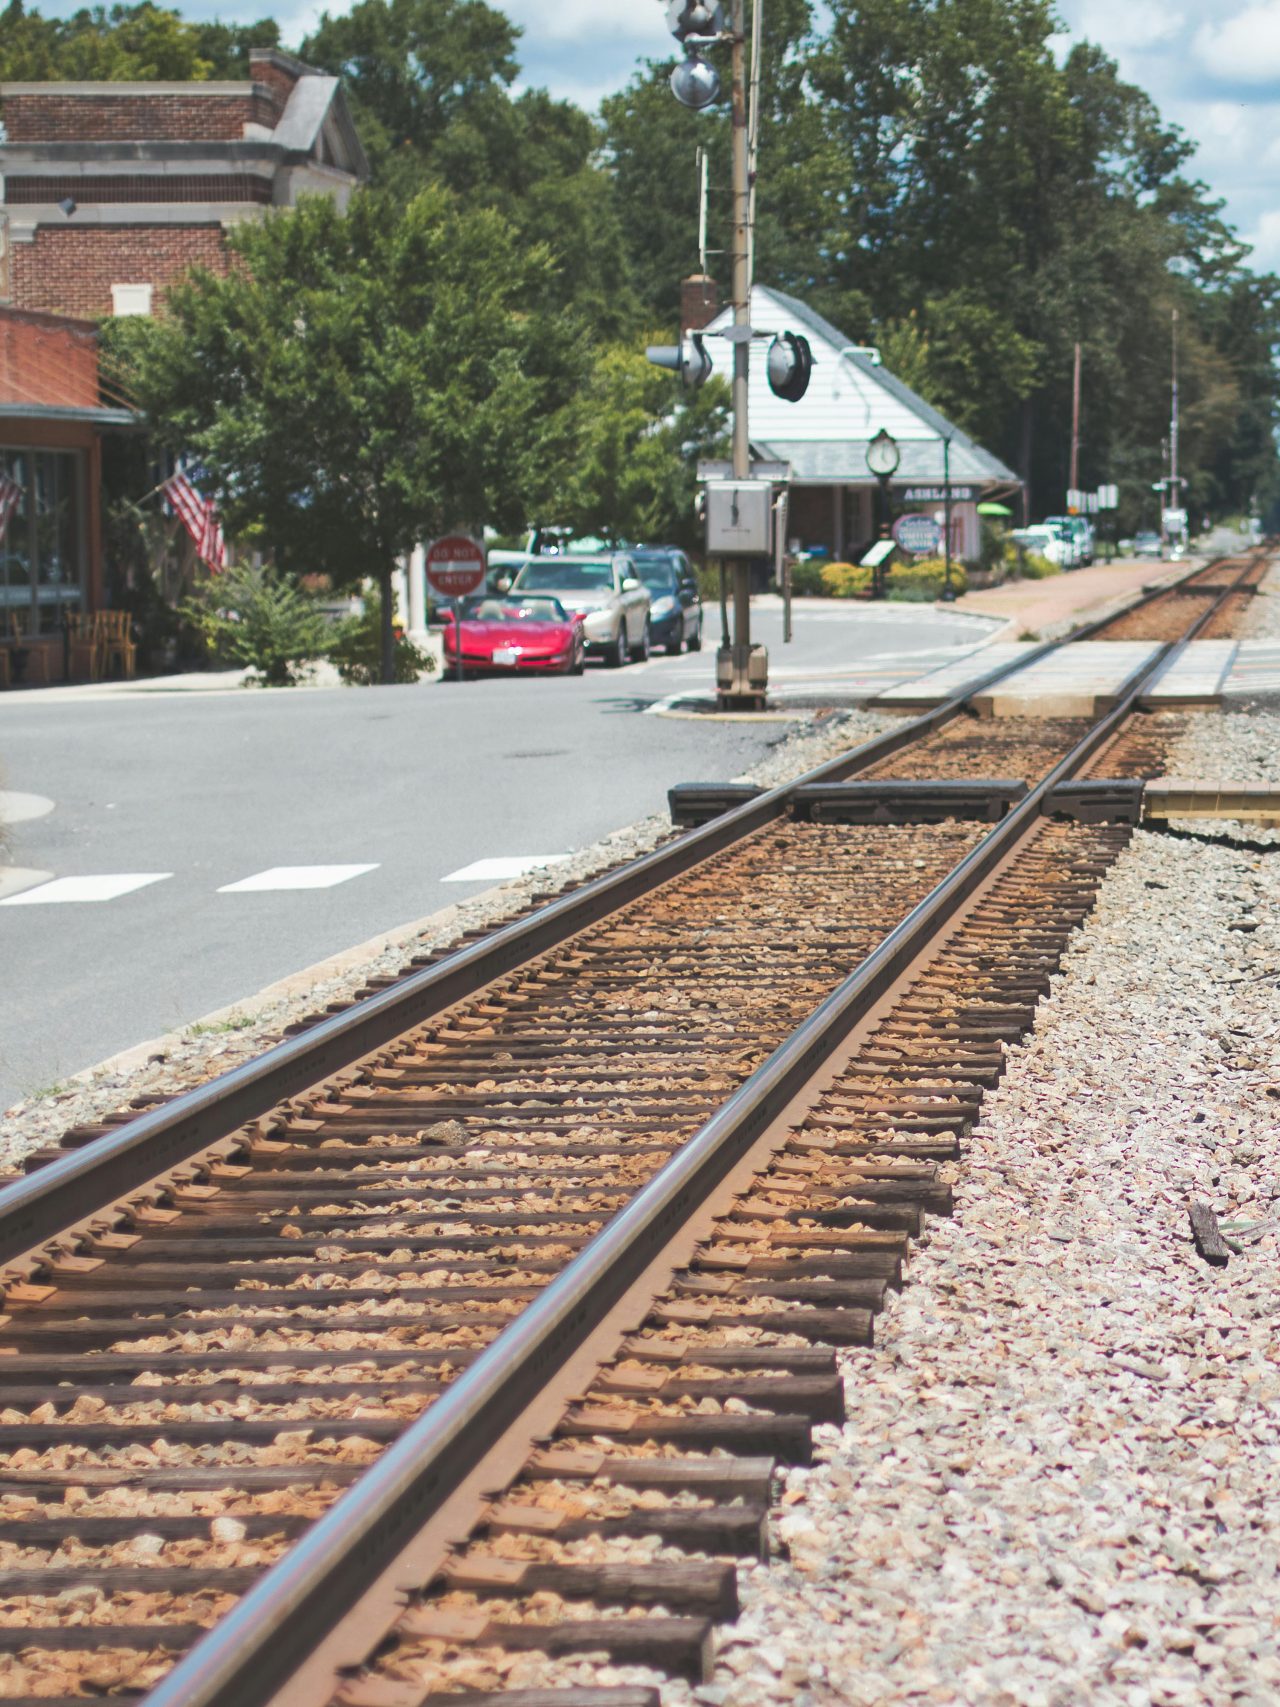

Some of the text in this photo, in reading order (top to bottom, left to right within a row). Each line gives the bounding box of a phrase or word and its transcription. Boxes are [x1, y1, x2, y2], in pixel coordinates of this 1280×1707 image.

[904, 487, 972, 500] ASHLAND
[433, 548, 476, 560] DO NOT
[438, 575, 473, 585] ENTER
